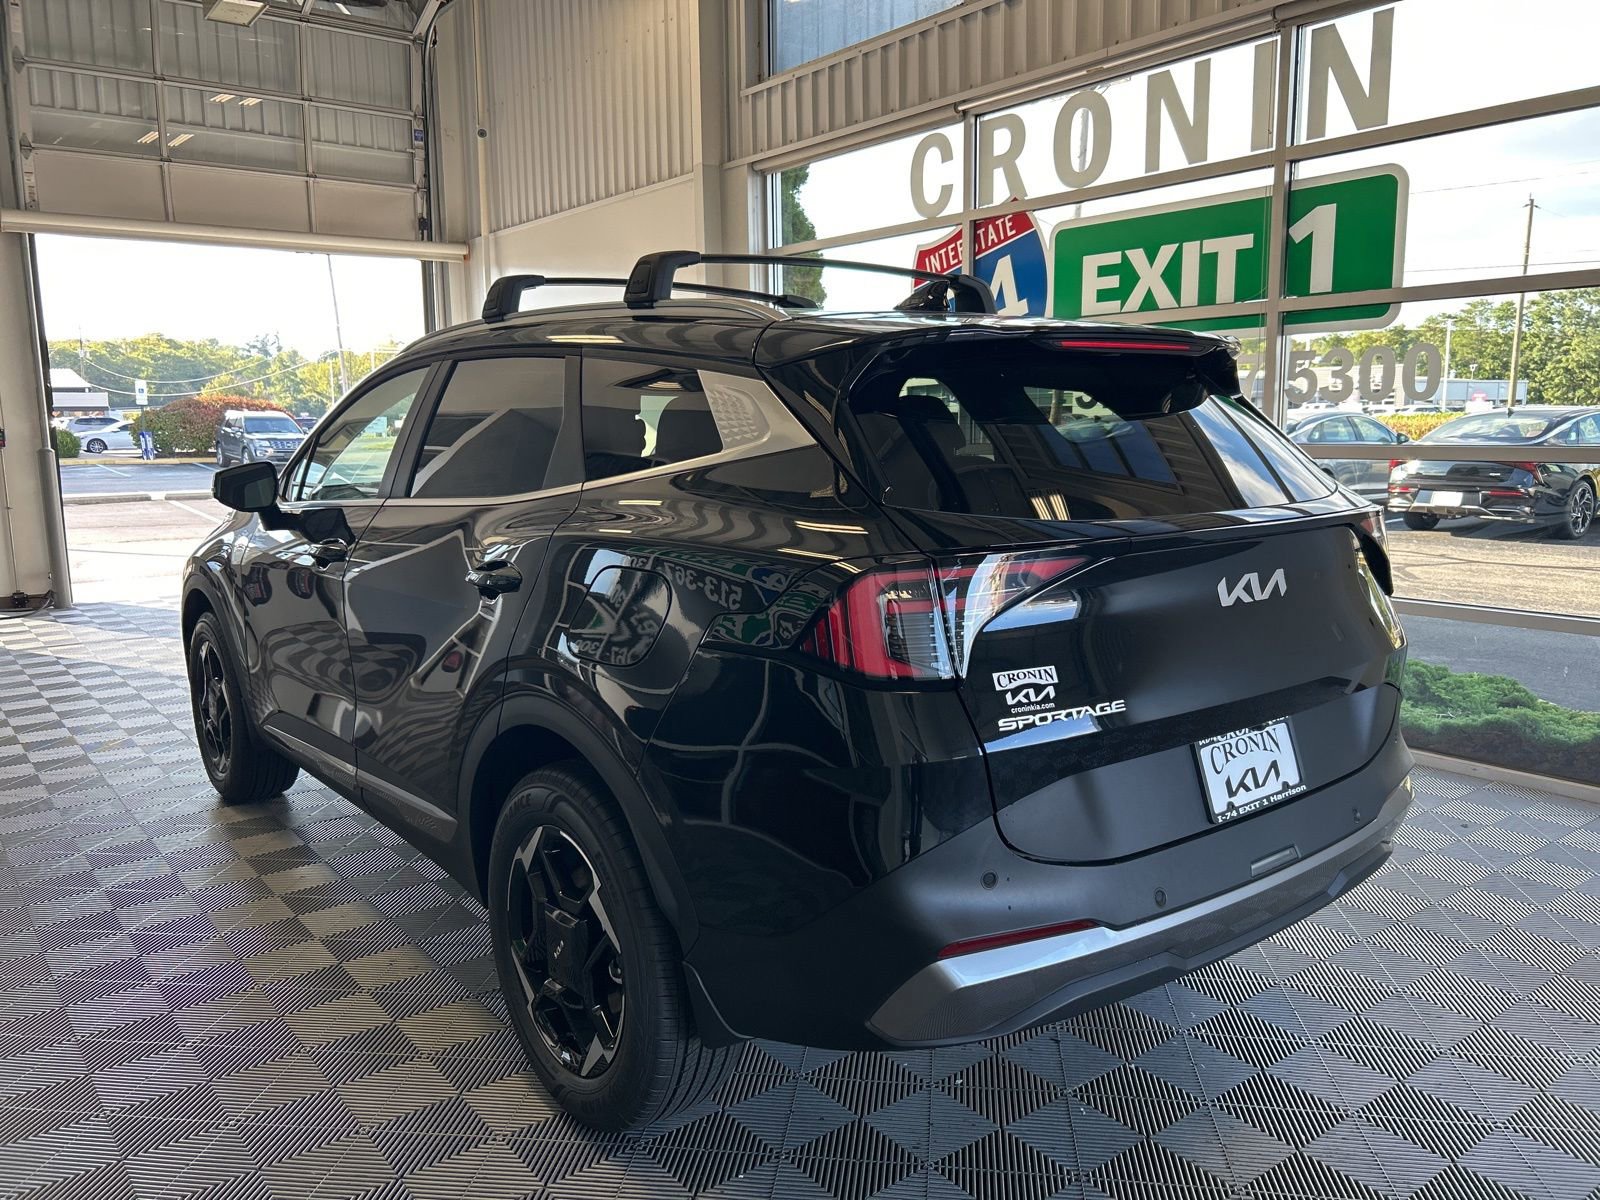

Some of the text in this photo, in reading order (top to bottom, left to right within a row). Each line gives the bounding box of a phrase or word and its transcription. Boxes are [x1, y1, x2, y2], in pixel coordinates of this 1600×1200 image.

[910, 6, 1395, 219] CRONIN
[925, 214, 1017, 273] INTERTATE
[1081, 203, 1337, 316] EXIT 1
[1217, 567, 1287, 607] KIA
[996, 667, 1055, 689] CRONIN
[1005, 685, 1056, 706] KIA
[998, 699, 1127, 732] SPORTAGE
[1010, 701, 1056, 714] croninkia.com
[1210, 728, 1282, 775] CRONIN
[1225, 759, 1281, 799] KIA
[1217, 784, 1307, 823] I-74 EXIT 1 Harrison
